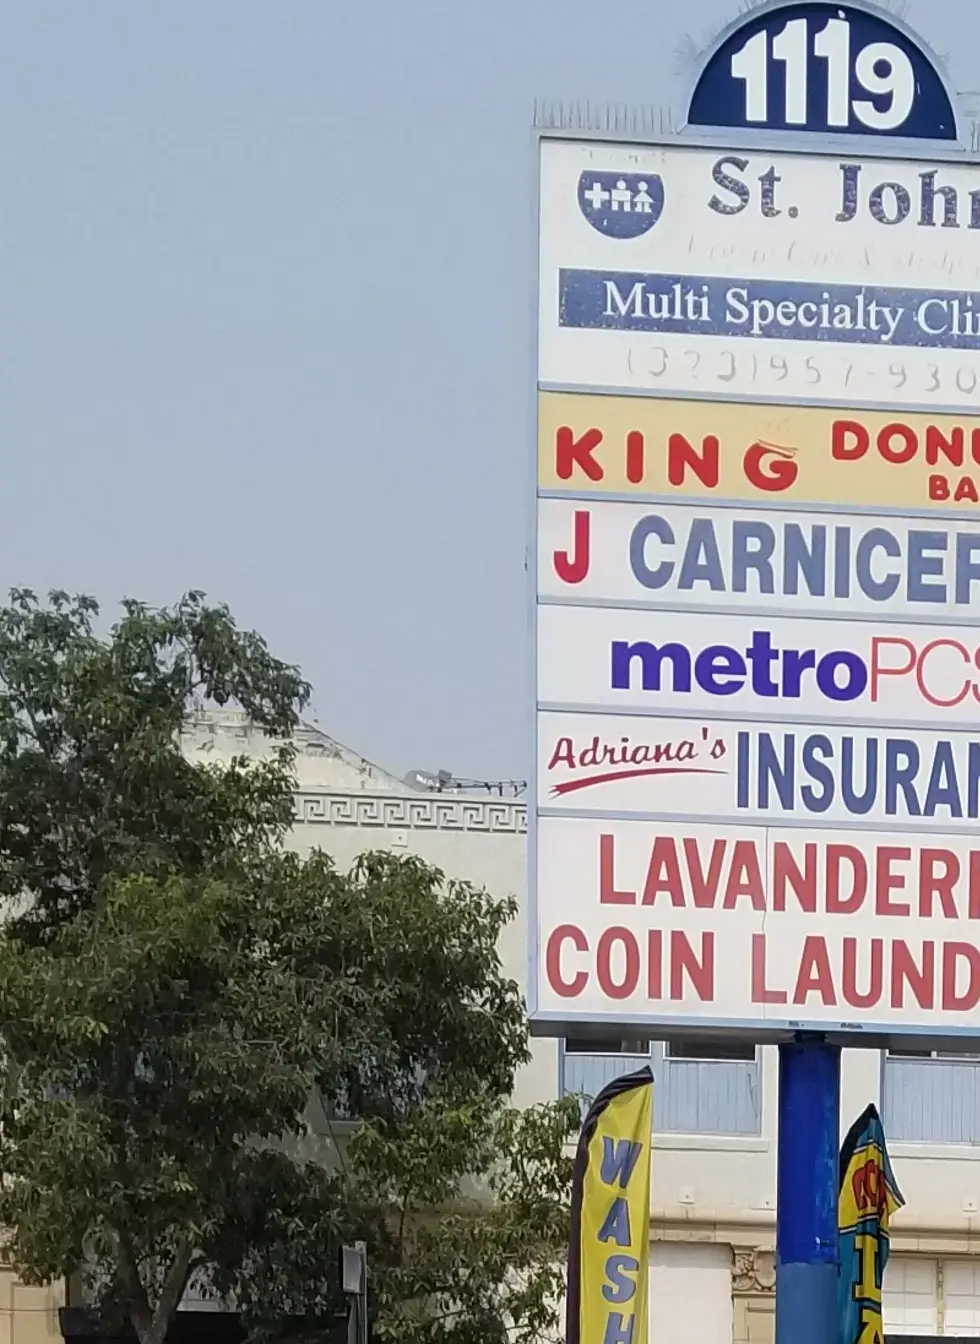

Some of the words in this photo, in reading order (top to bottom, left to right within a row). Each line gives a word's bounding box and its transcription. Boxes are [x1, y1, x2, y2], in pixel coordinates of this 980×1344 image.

[731, 17, 916, 130] 1119
[707, 155, 800, 219] St.
[602, 280, 711, 323] Multi
[724, 287, 904, 342] Specialty
[555, 425, 799, 491] KING
[554, 510, 590, 584] J
[547, 727, 727, 770] Adriana's
[546, 923, 715, 1002] COIN
